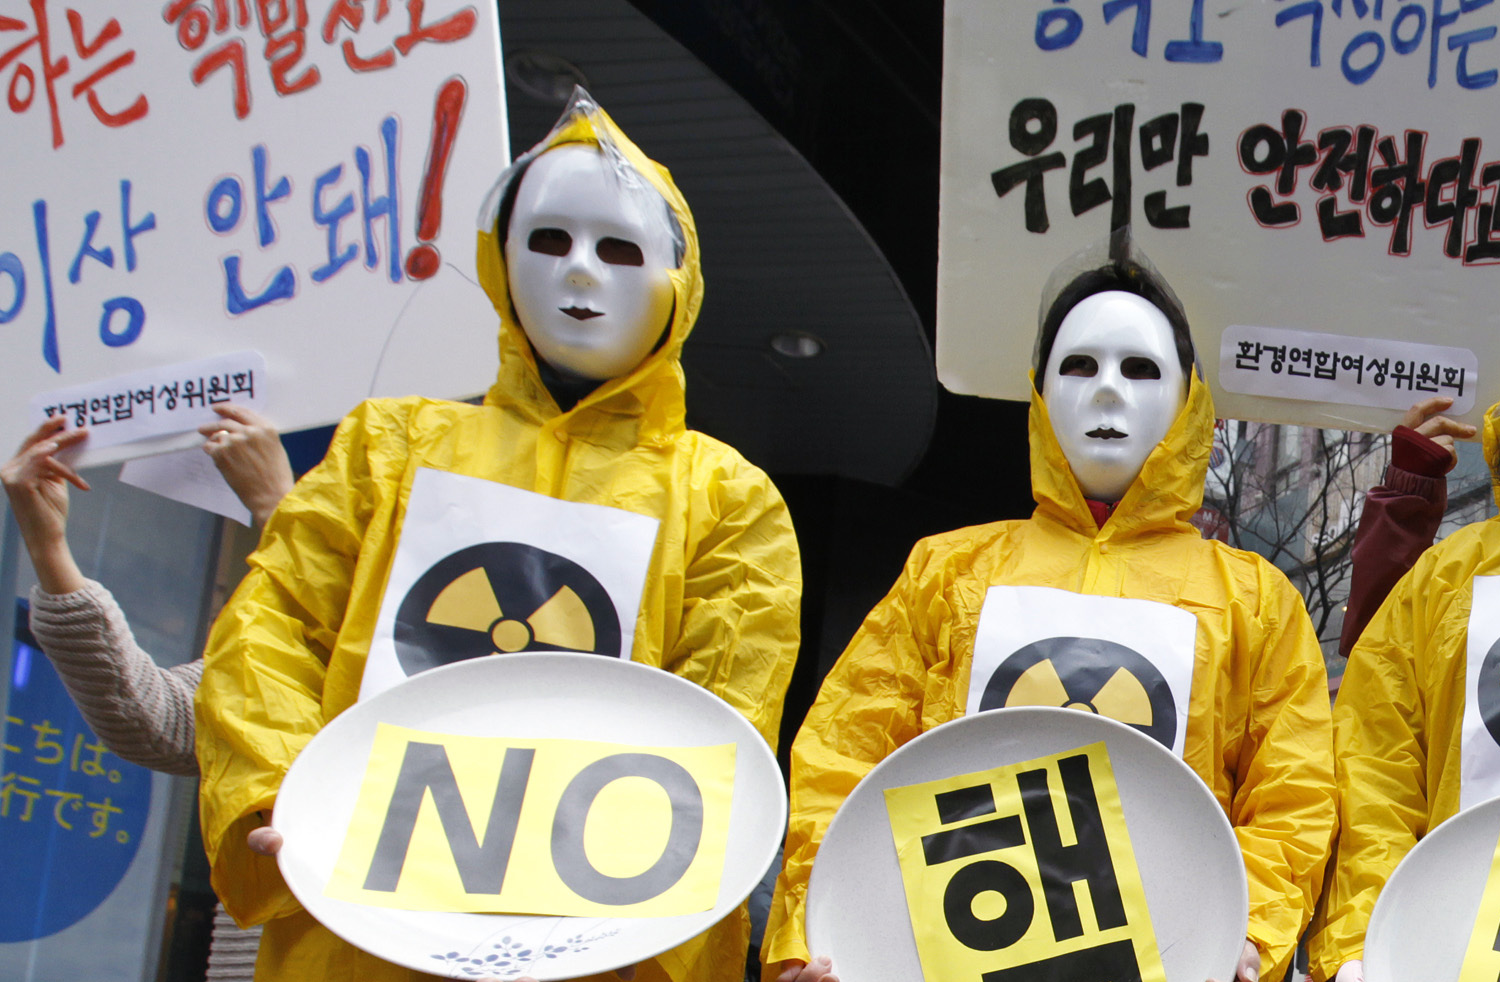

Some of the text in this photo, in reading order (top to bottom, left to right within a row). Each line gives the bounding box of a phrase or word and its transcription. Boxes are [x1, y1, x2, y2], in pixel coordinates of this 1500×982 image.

[0, 0, 149, 150] 하는
[991, 97, 1209, 262] 우리만
[0, 178, 156, 373] 이상
[1236, 340, 1465, 397] 환경연합여성위원회
[362, 740, 704, 907] NO
